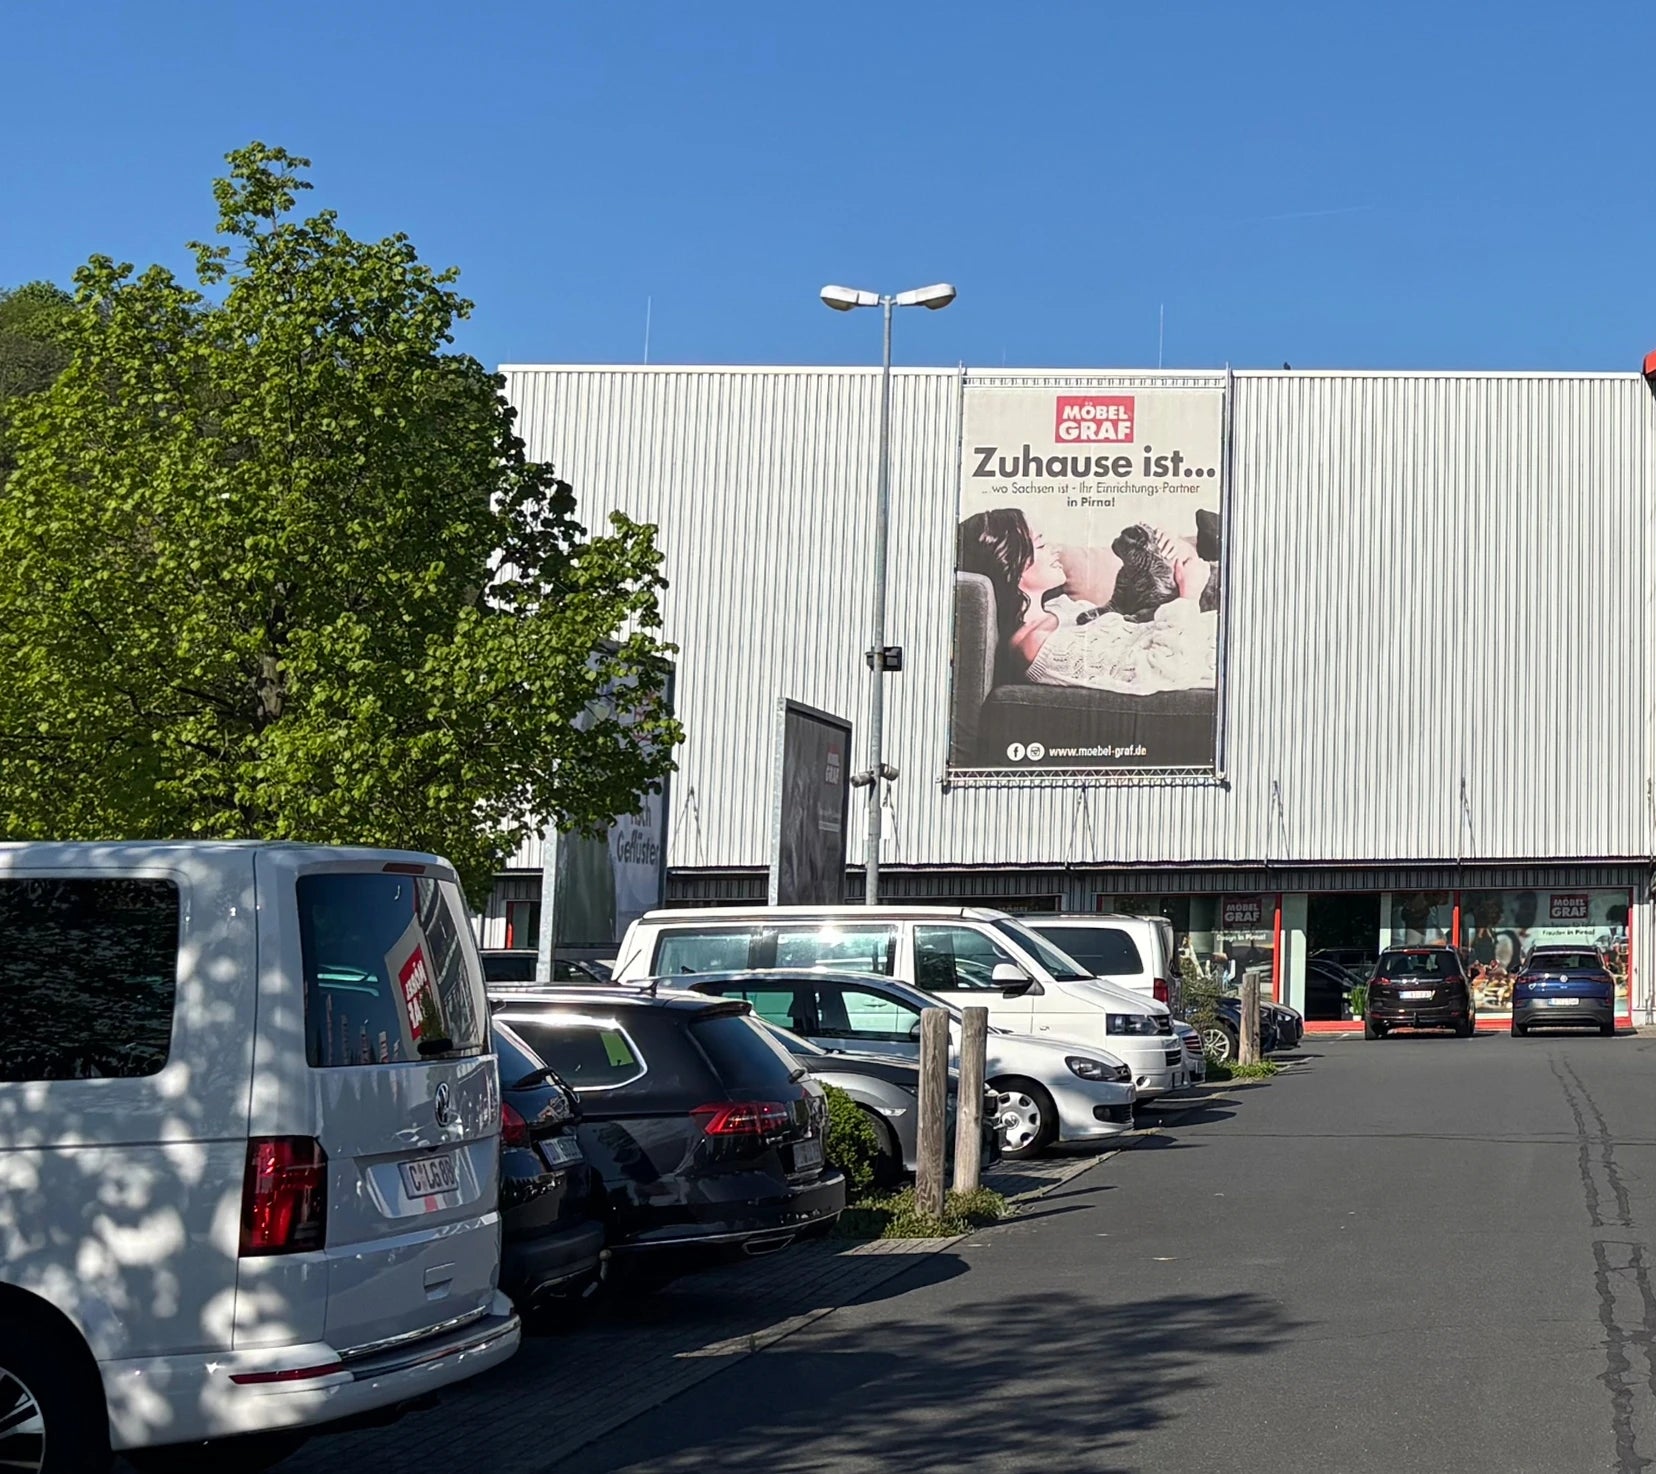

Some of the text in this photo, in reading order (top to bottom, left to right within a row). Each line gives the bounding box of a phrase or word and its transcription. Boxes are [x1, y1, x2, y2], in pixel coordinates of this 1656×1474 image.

[1062, 402, 1129, 420] MÖBEL
[1058, 421, 1131, 440] GRAF
[972, 444, 1216, 477] Zuhause ist...
[992, 485, 1008, 494] wo
[1012, 482, 1054, 494] Sachsen
[1058, 484, 1069, 494] ist
[1079, 482, 1092, 494] Ihr
[1096, 482, 1201, 497] Einrichtungs-Partner
[1067, 497, 1116, 508] in Pirna!
[1049, 744, 1147, 758] www.moebel-graf.de
[1551, 906, 1587, 917] GRAF
